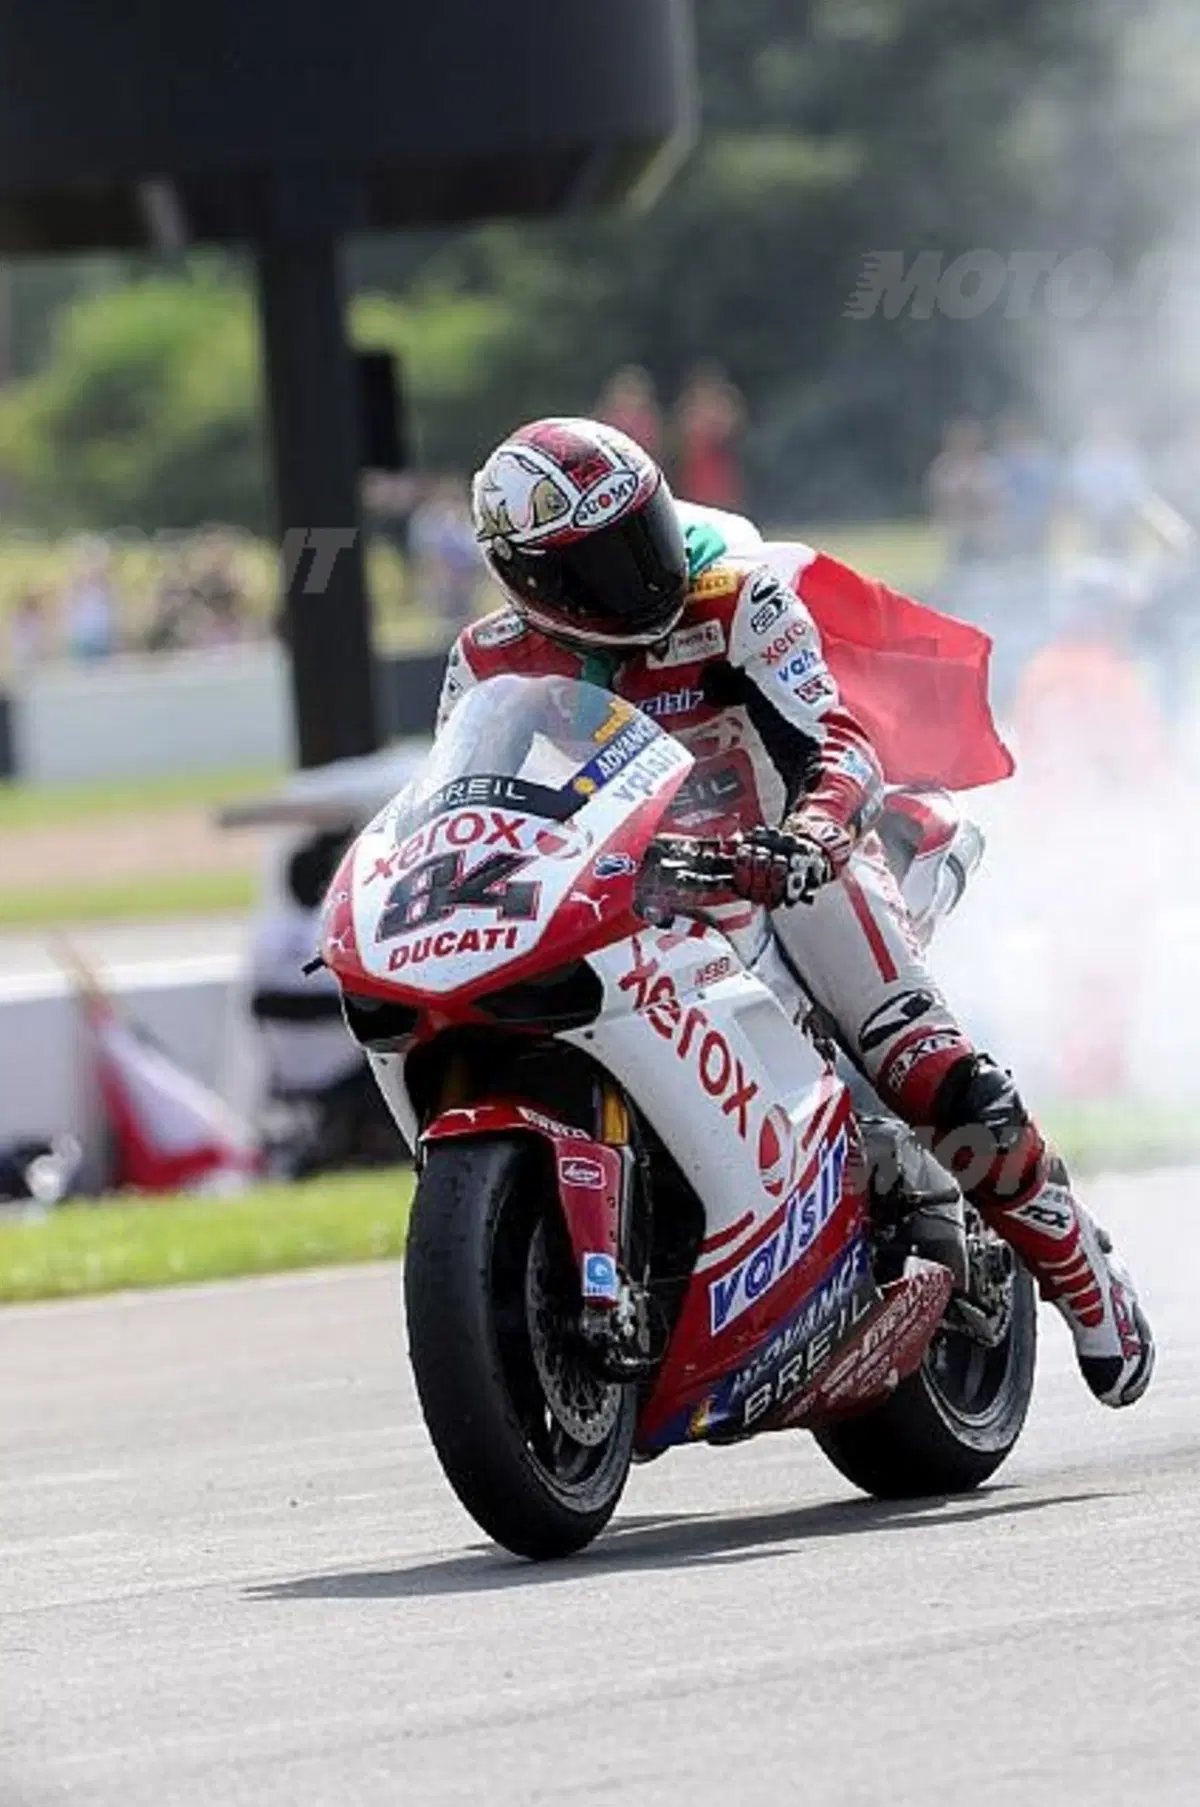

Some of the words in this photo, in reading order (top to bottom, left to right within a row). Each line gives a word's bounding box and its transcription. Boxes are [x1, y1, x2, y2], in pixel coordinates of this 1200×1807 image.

[362, 811, 527, 887] xerox
[374, 848, 543, 944] 84
[387, 925, 519, 972] DUCATI
[617, 934, 759, 1140] xerox
[742, 1293, 873, 1429] BREIL
